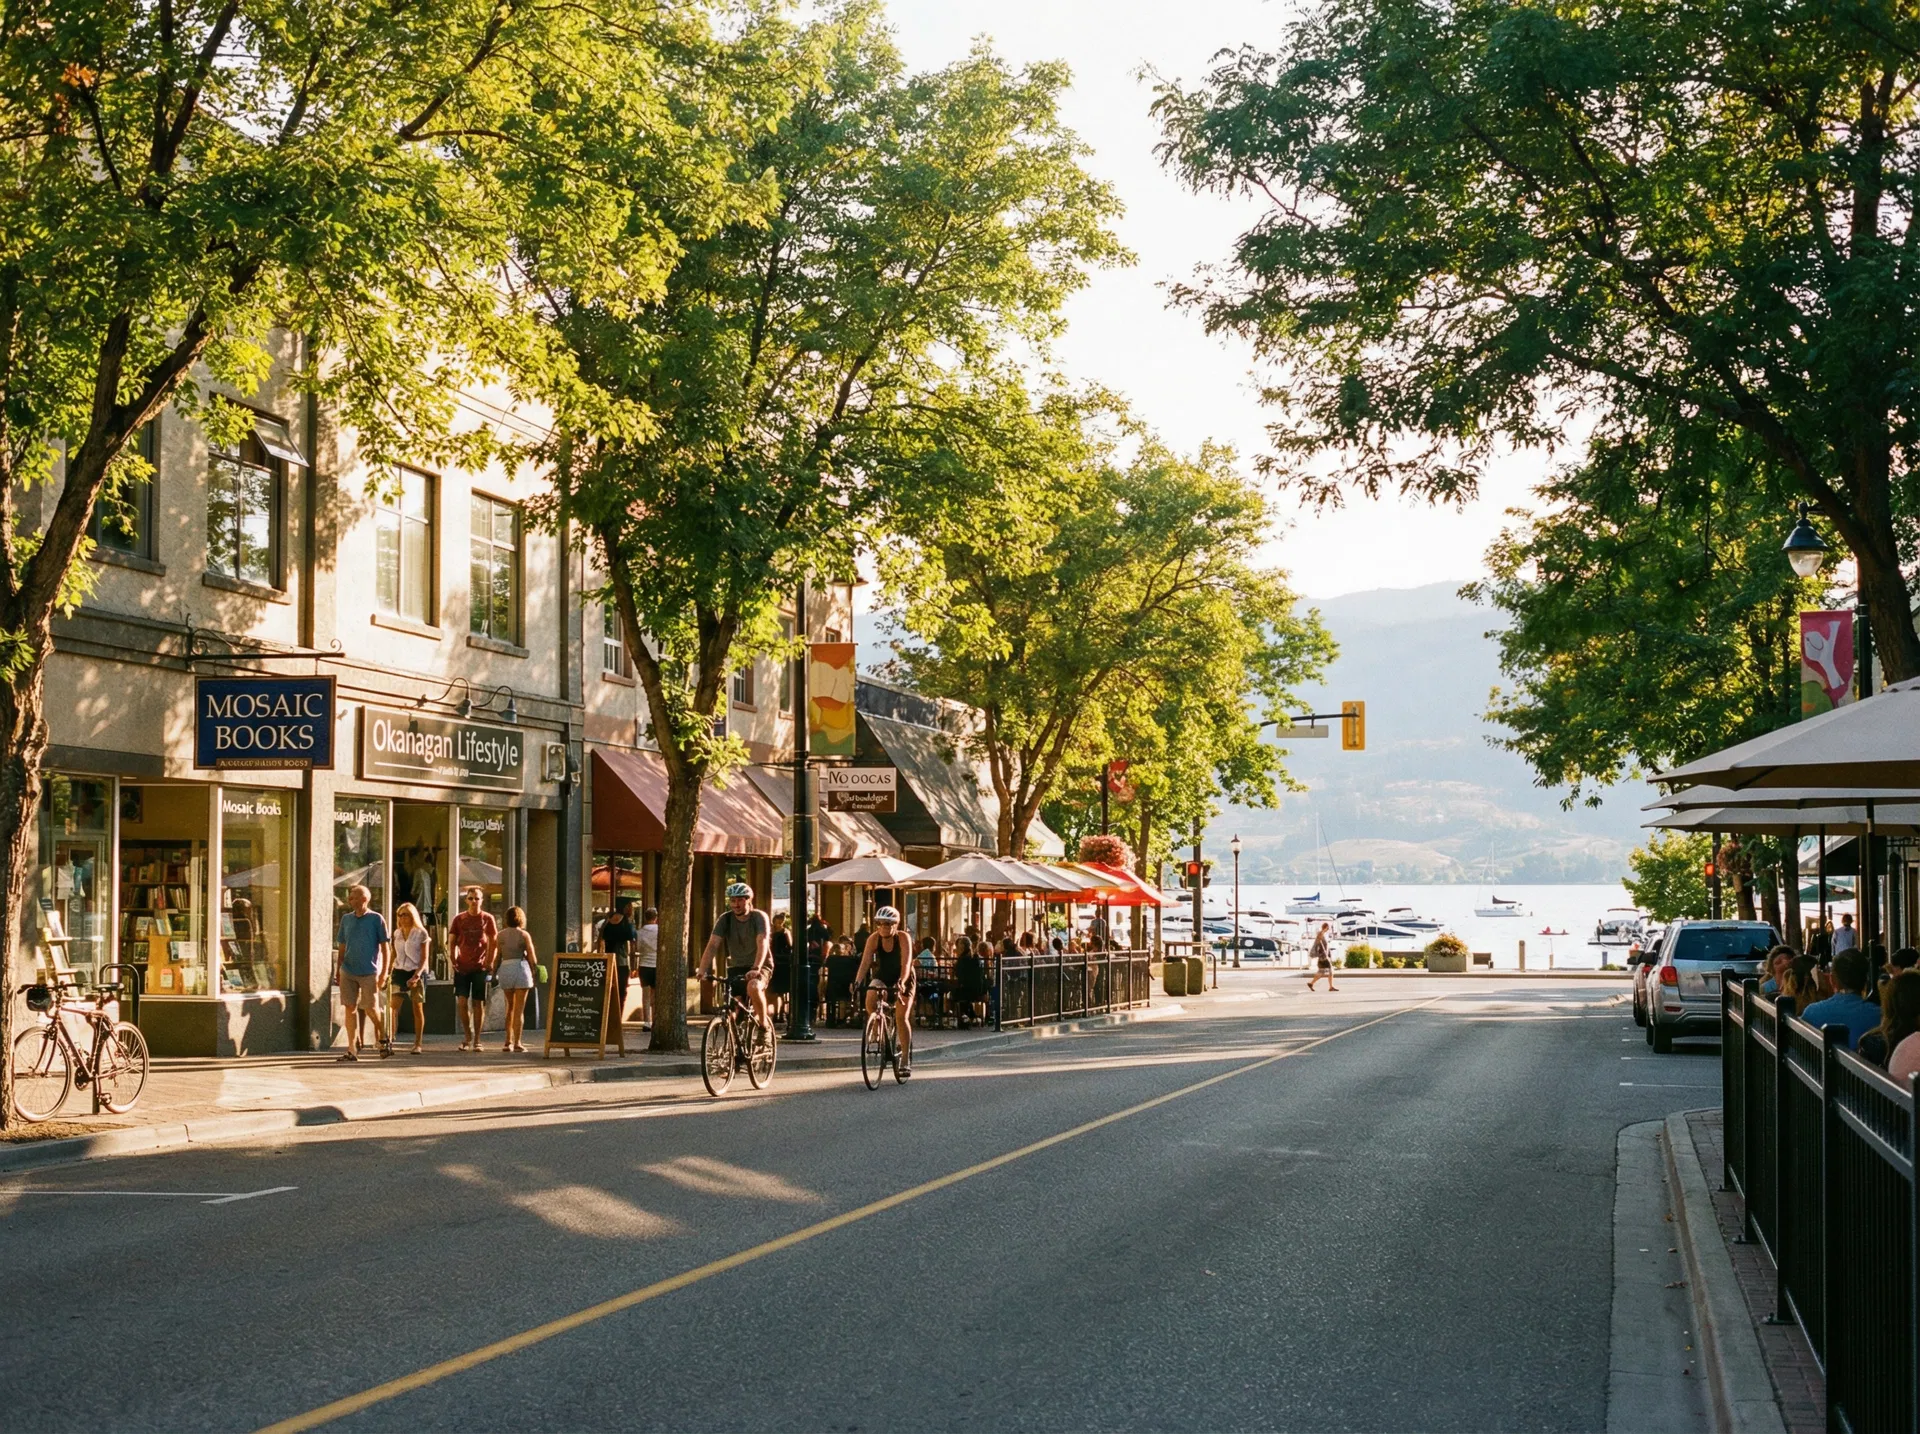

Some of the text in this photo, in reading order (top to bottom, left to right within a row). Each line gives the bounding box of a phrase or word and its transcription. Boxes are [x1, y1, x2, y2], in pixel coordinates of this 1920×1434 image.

[206, 693, 323, 718] MOSAIC
[215, 725, 315, 750] BOOKS
[373, 719, 519, 772] Okanagan Lifestyle
[222, 800, 281, 818] Mosaic Books
[560, 971, 599, 987] Books
